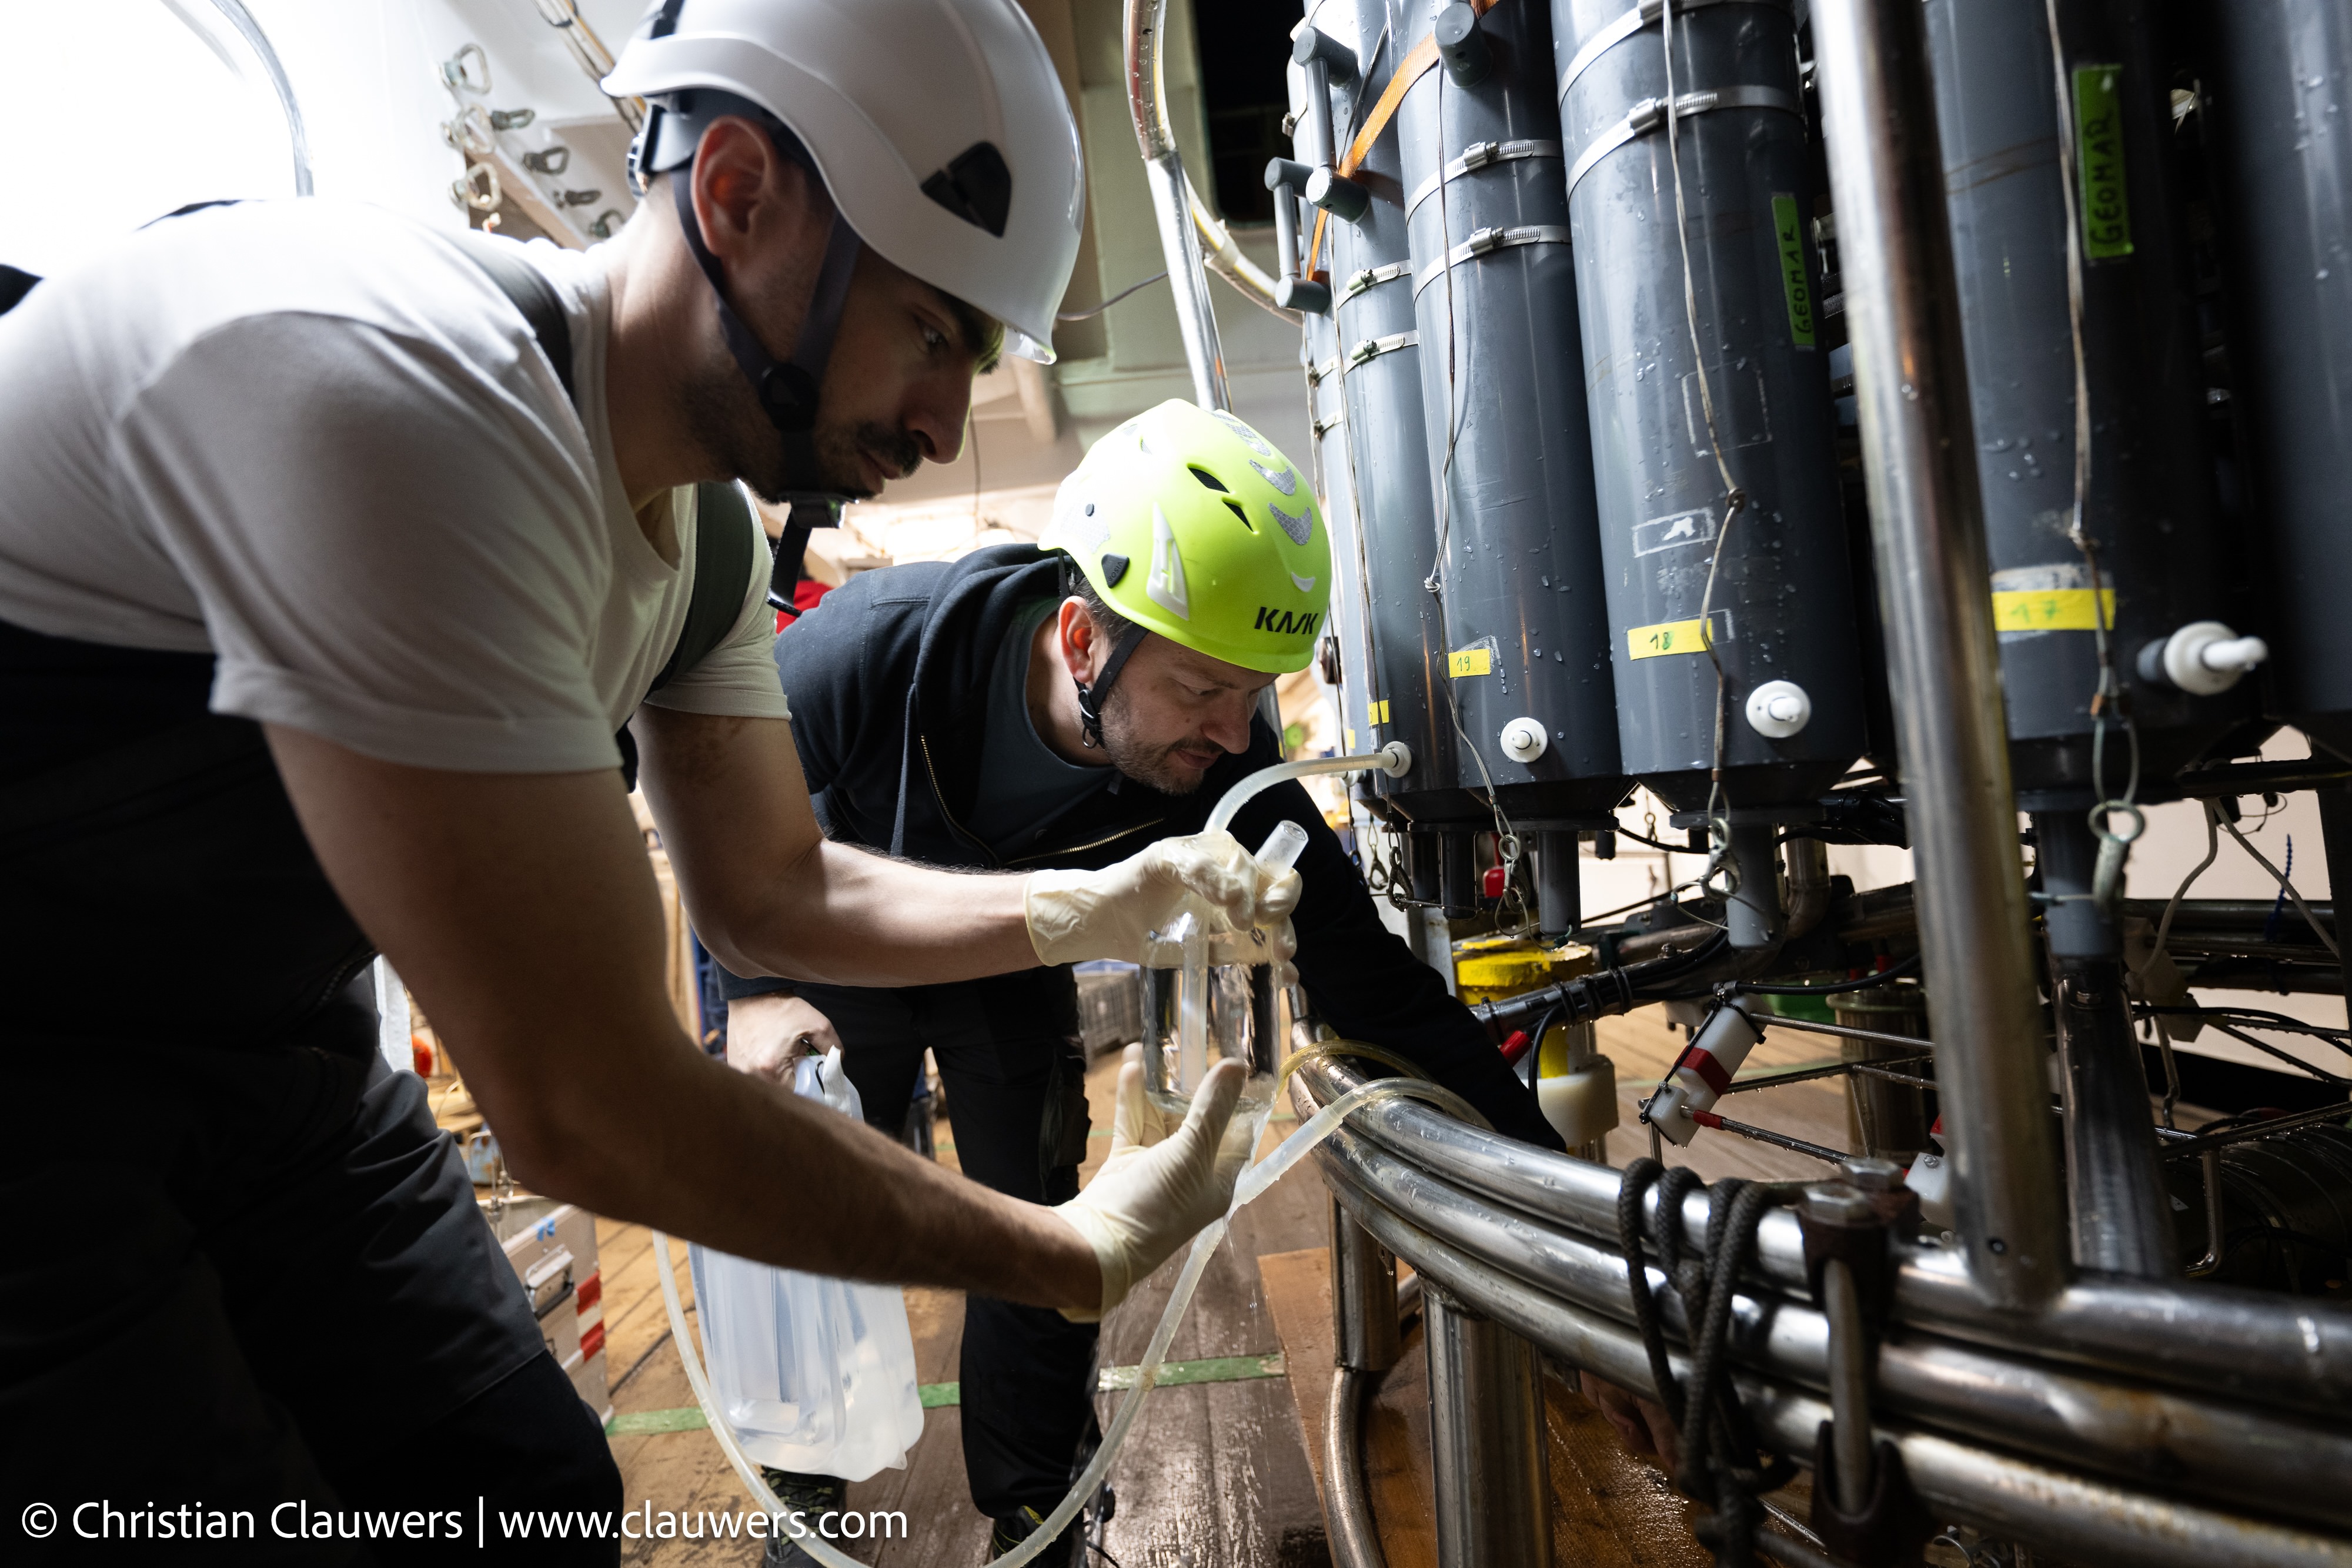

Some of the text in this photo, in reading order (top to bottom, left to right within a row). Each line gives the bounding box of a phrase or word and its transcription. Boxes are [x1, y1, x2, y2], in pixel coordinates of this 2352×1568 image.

[1782, 225, 1812, 334] GEOMAR
[1254, 606, 1319, 635] KASK
[1649, 631, 1673, 650] 18
[1456, 656, 1470, 671] 19
